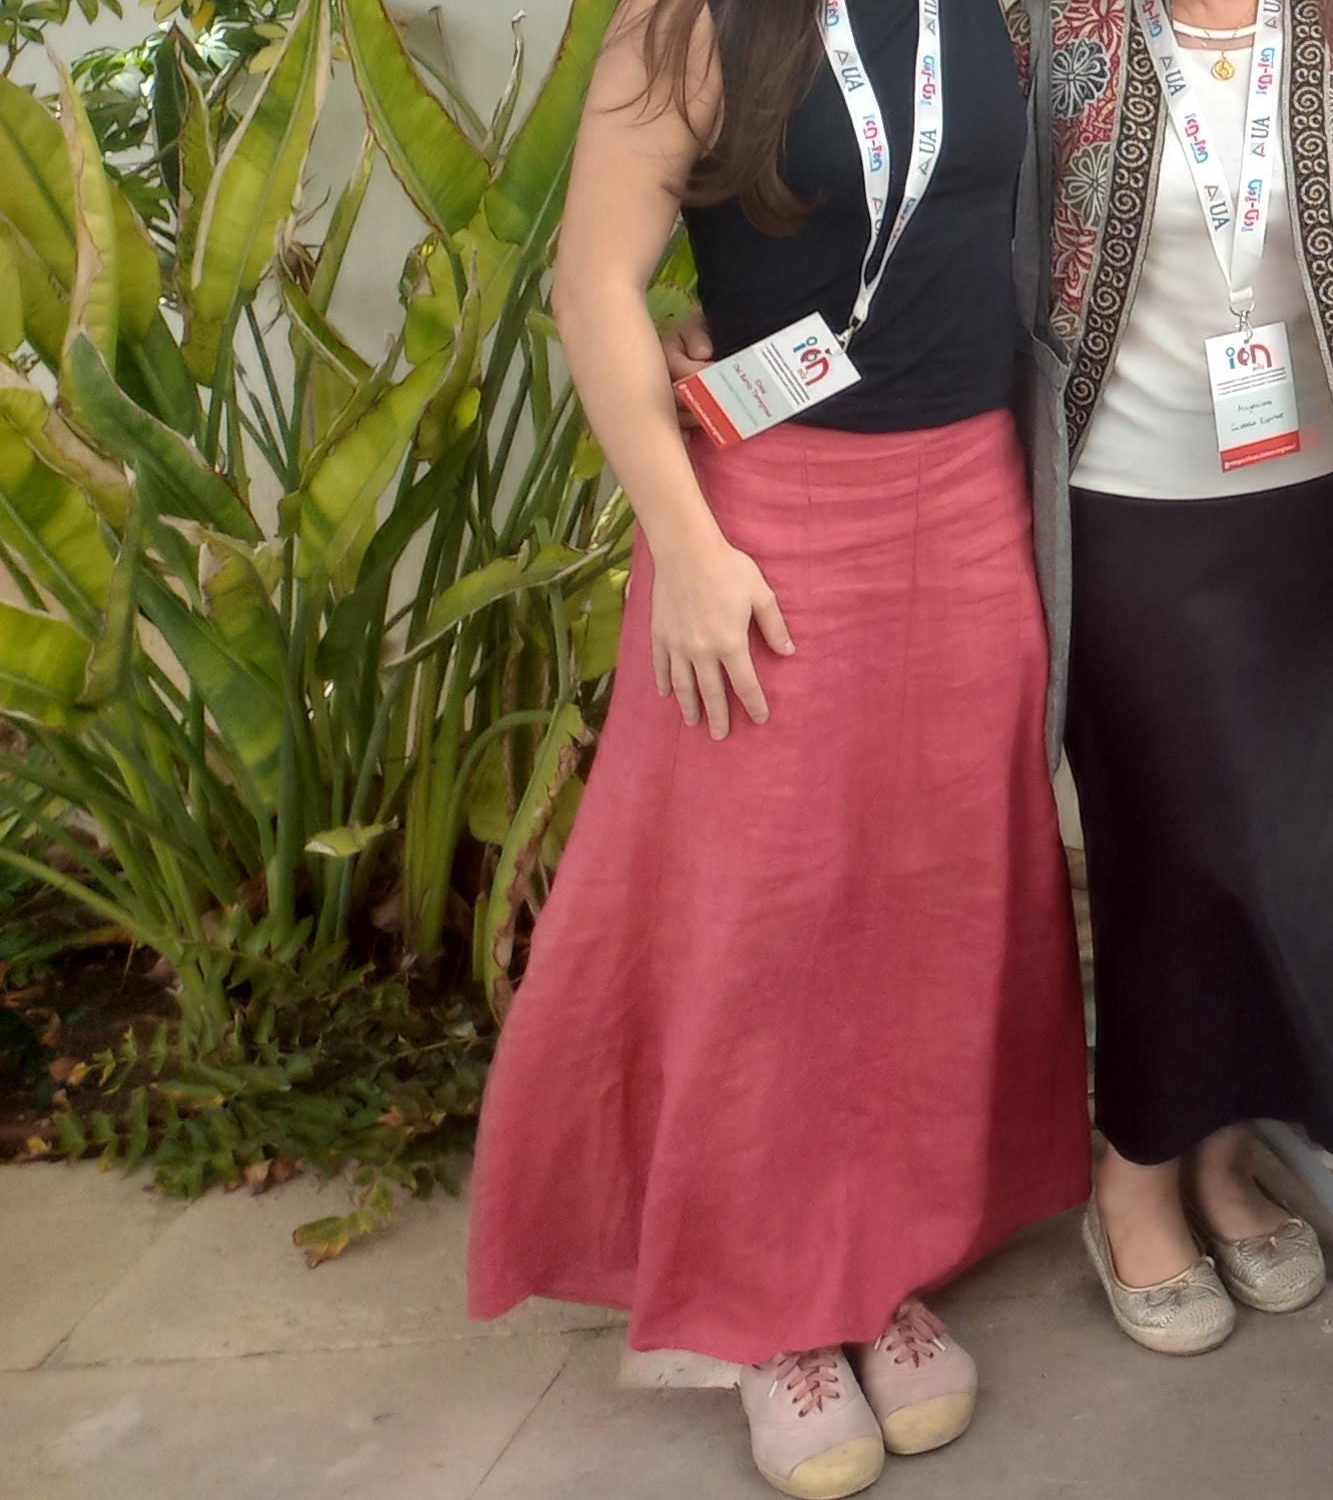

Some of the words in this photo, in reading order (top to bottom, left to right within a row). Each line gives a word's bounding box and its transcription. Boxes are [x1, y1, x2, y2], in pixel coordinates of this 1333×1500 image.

[841, 66, 864, 95] UA
[1165, 68, 1187, 99] UA
[917, 127, 938, 158] UA
[1250, 114, 1271, 142] UA
[1209, 201, 1232, 233] UA
